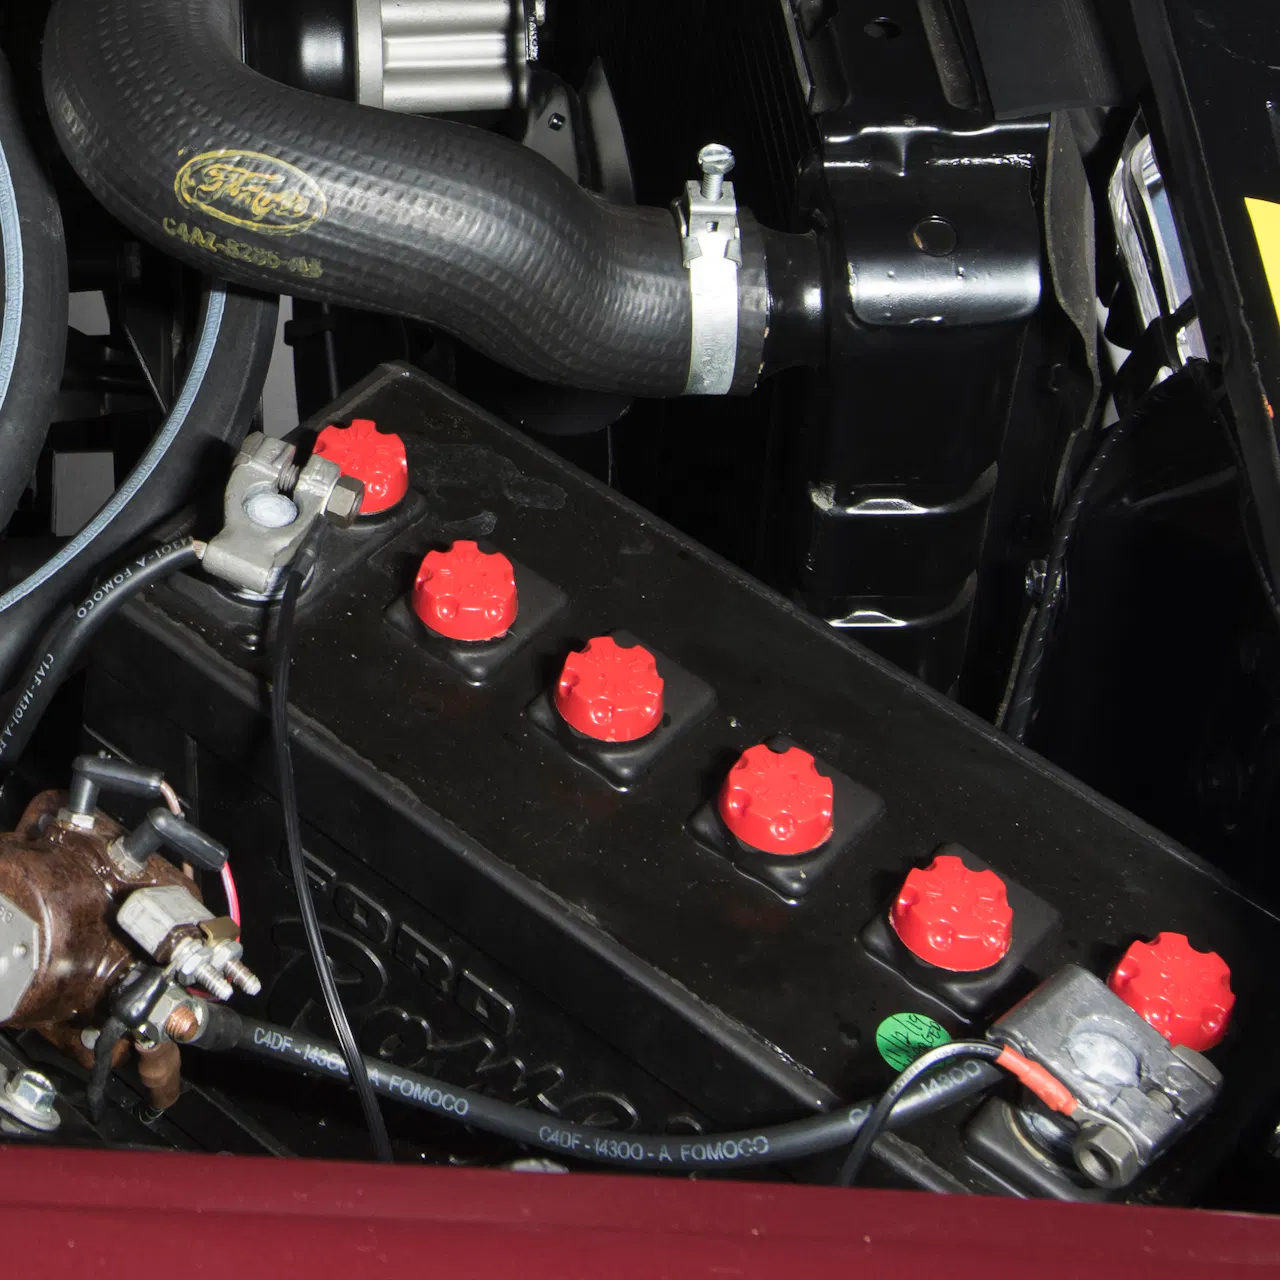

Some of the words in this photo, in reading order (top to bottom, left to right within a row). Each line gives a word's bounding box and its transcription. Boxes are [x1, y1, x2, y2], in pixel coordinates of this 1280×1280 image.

[76, 567, 133, 620] FOMOCO
[389, 1074, 470, 1117] FOMOCO
[680, 1134, 770, 1162] FOMOCO
